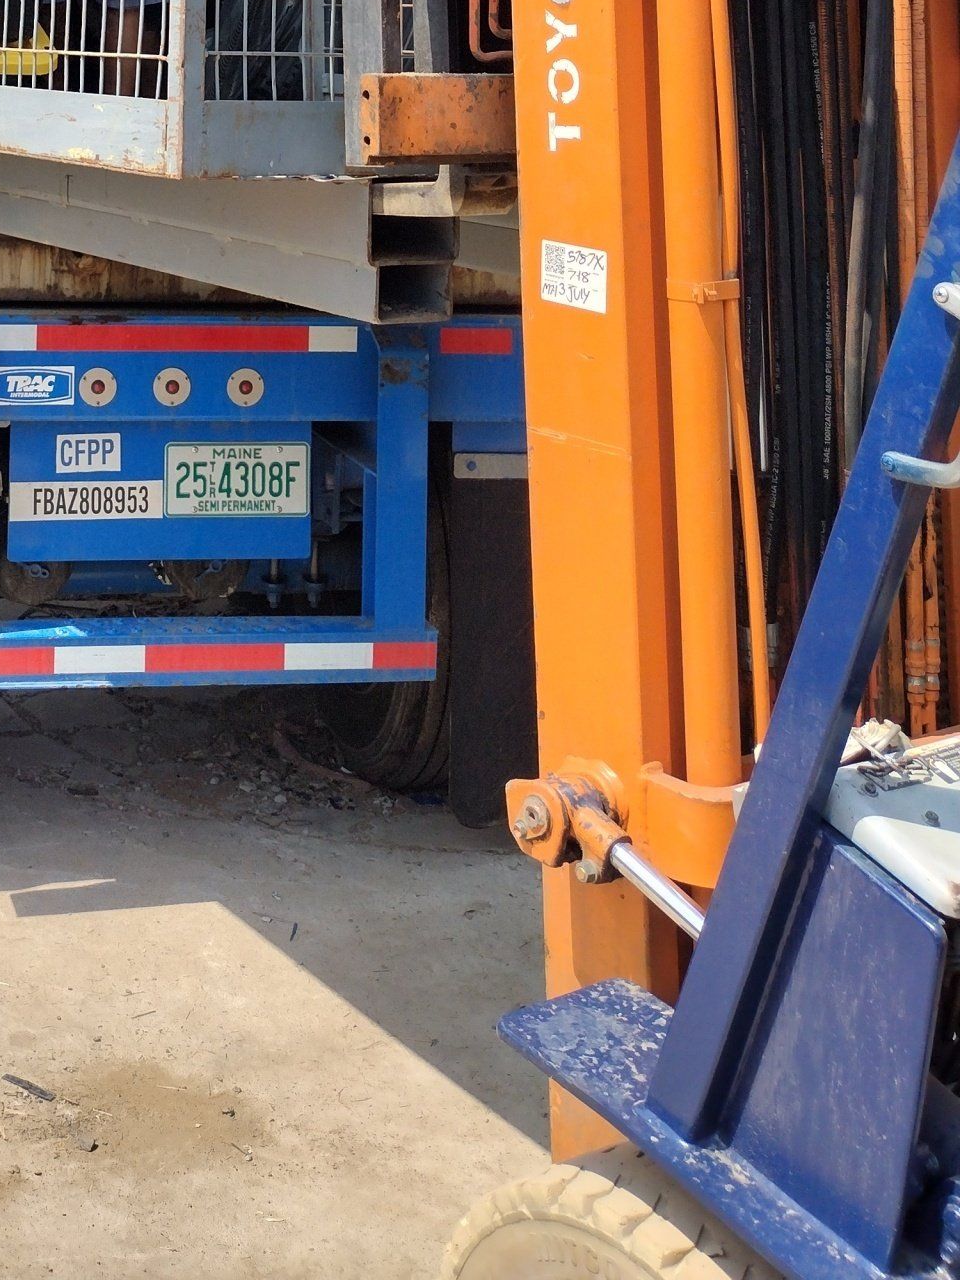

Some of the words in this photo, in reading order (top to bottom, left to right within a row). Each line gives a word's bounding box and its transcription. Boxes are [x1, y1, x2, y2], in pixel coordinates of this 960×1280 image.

[566, 285, 591, 304] JULY
[7, 375, 56, 393] TRAC
[60, 438, 115, 467] CFPP
[212, 447, 262, 459] MAINE
[33, 485, 149, 516] FBAZ808953
[198, 500, 219, 512] SEMI
[221, 499, 276, 512] PERMANENT
